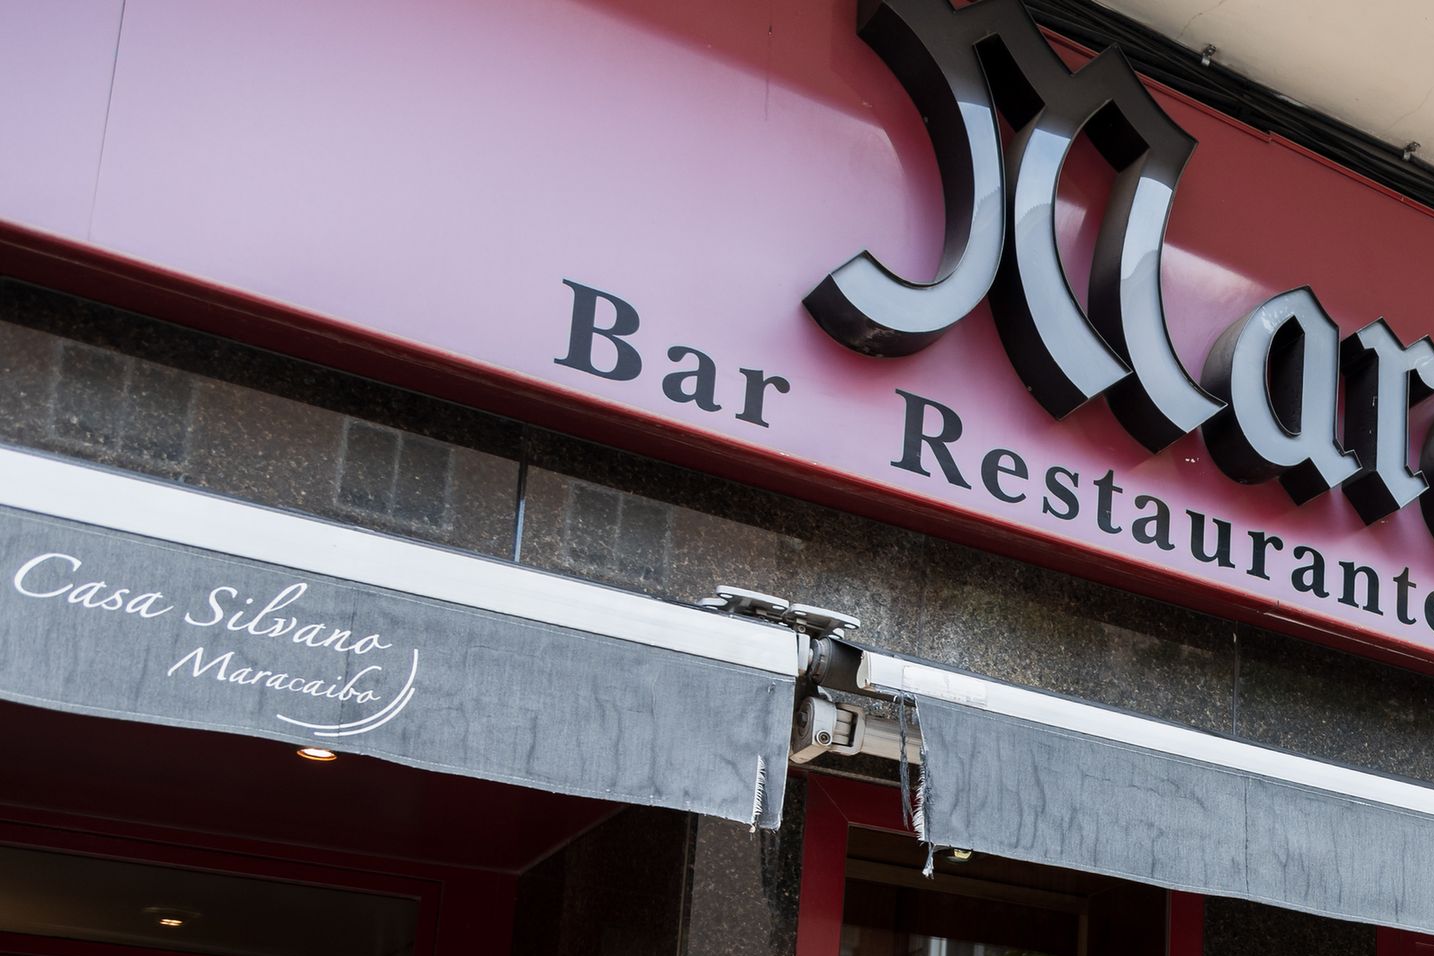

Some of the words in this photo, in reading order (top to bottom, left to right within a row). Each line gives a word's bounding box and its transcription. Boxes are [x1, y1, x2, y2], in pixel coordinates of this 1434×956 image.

[554, 278, 791, 429] Bar
[14, 553, 173, 618] Casa
[184, 583, 392, 655] Silvano
[168, 647, 382, 704] Maracaibo
